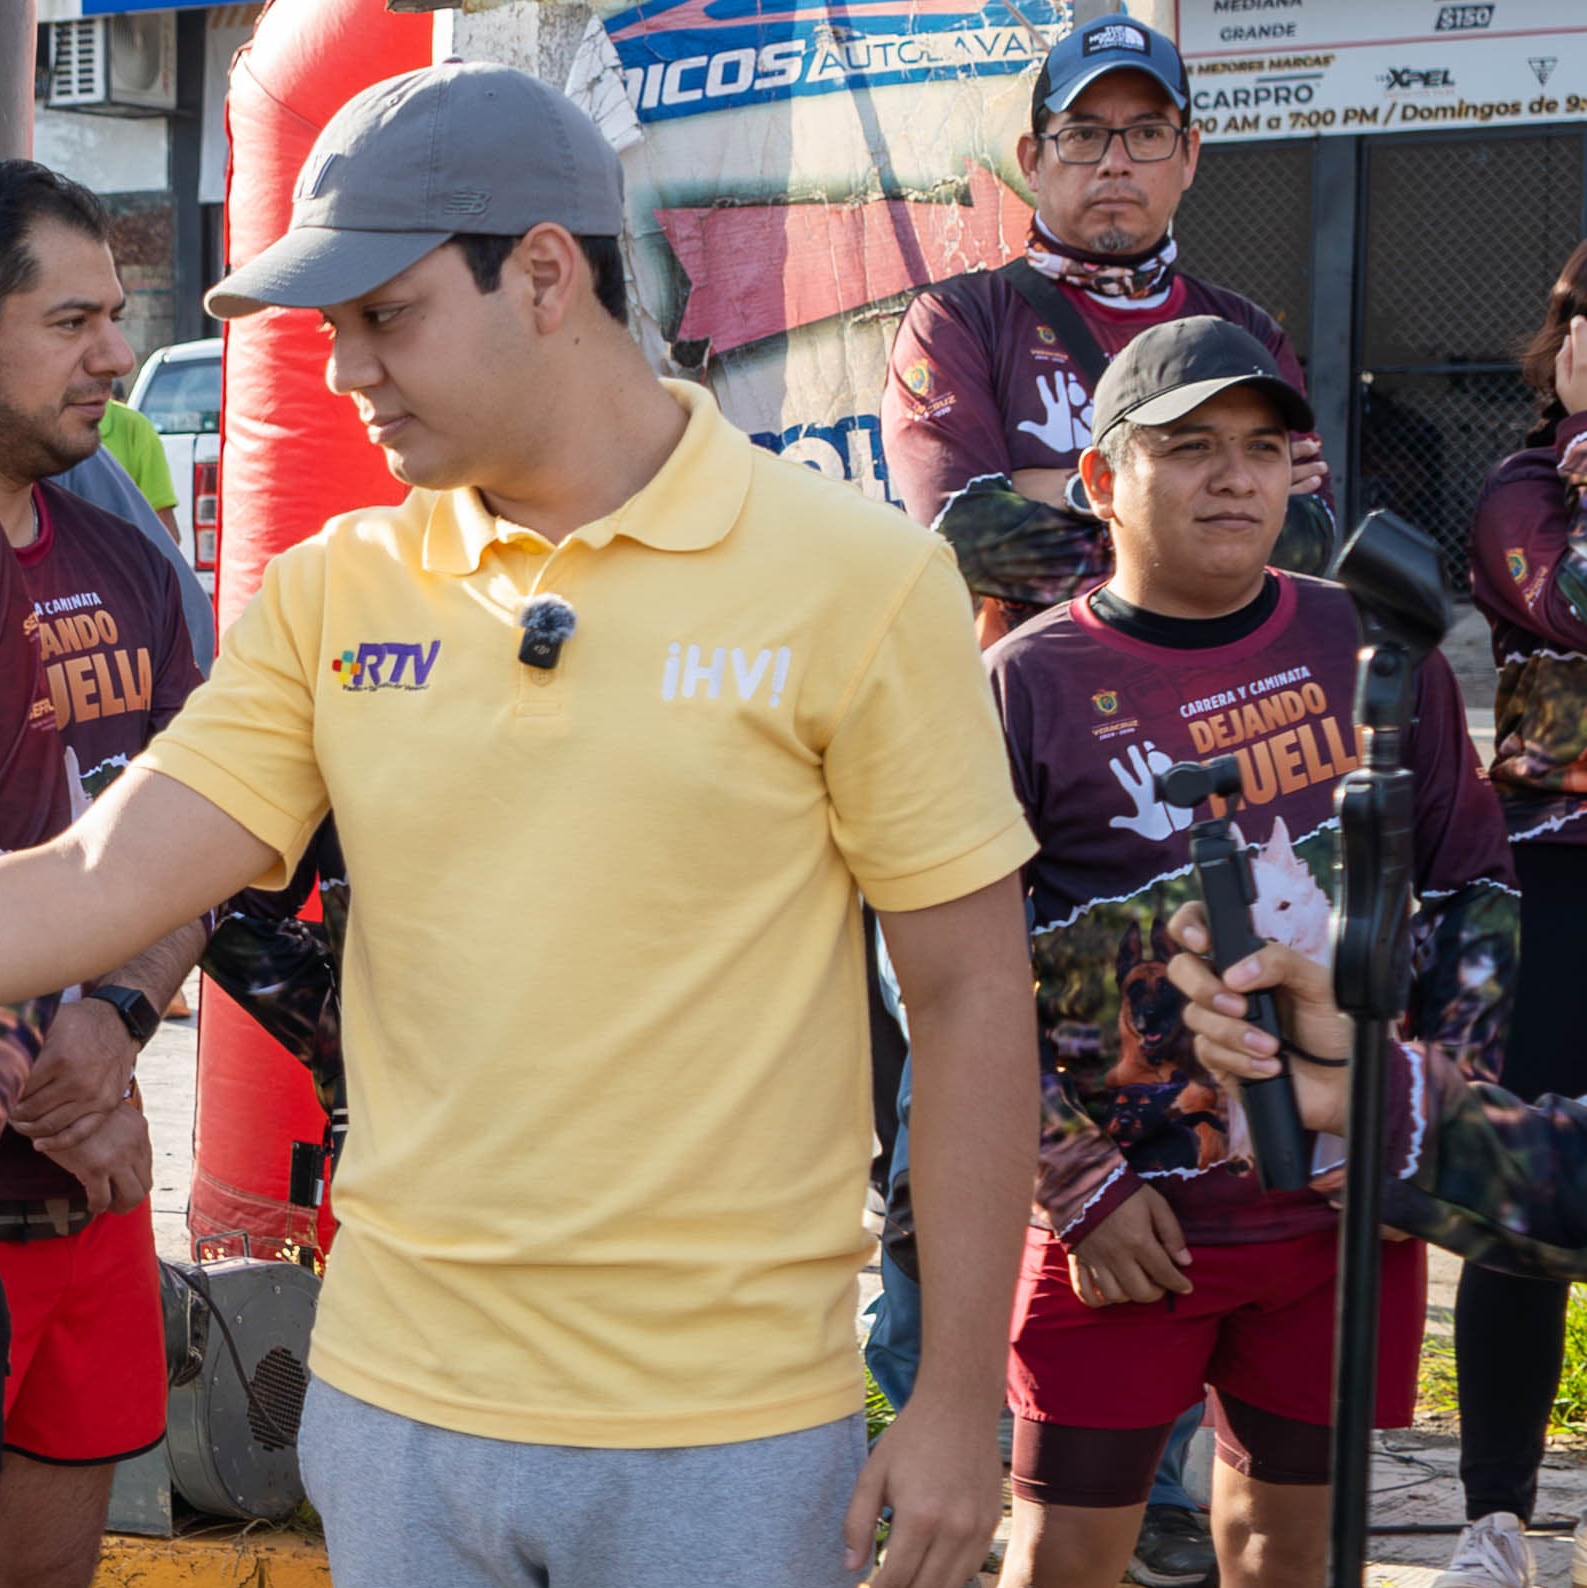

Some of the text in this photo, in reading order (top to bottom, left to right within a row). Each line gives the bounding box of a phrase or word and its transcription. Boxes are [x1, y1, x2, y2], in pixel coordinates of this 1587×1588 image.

[1220, 22, 1297, 41] GRANDE
[1193, 84, 1314, 110] CARPRO
[1223, 113, 1261, 133] AM
[1267, 115, 1281, 130] a
[1289, 109, 1335, 129] 7:00
[1342, 105, 1379, 127] PM
[1400, 98, 1522, 122] Domingos
[1528, 95, 1559, 116] de
[45, 592, 102, 615] CAMINATA
[39, 610, 118, 661] ANDO
[353, 640, 441, 686] RTV
[1180, 665, 1311, 718] CARRERA Y CAMINATA
[1188, 682, 1327, 754] DEJANDO
[1202, 716, 1364, 818] UELL
